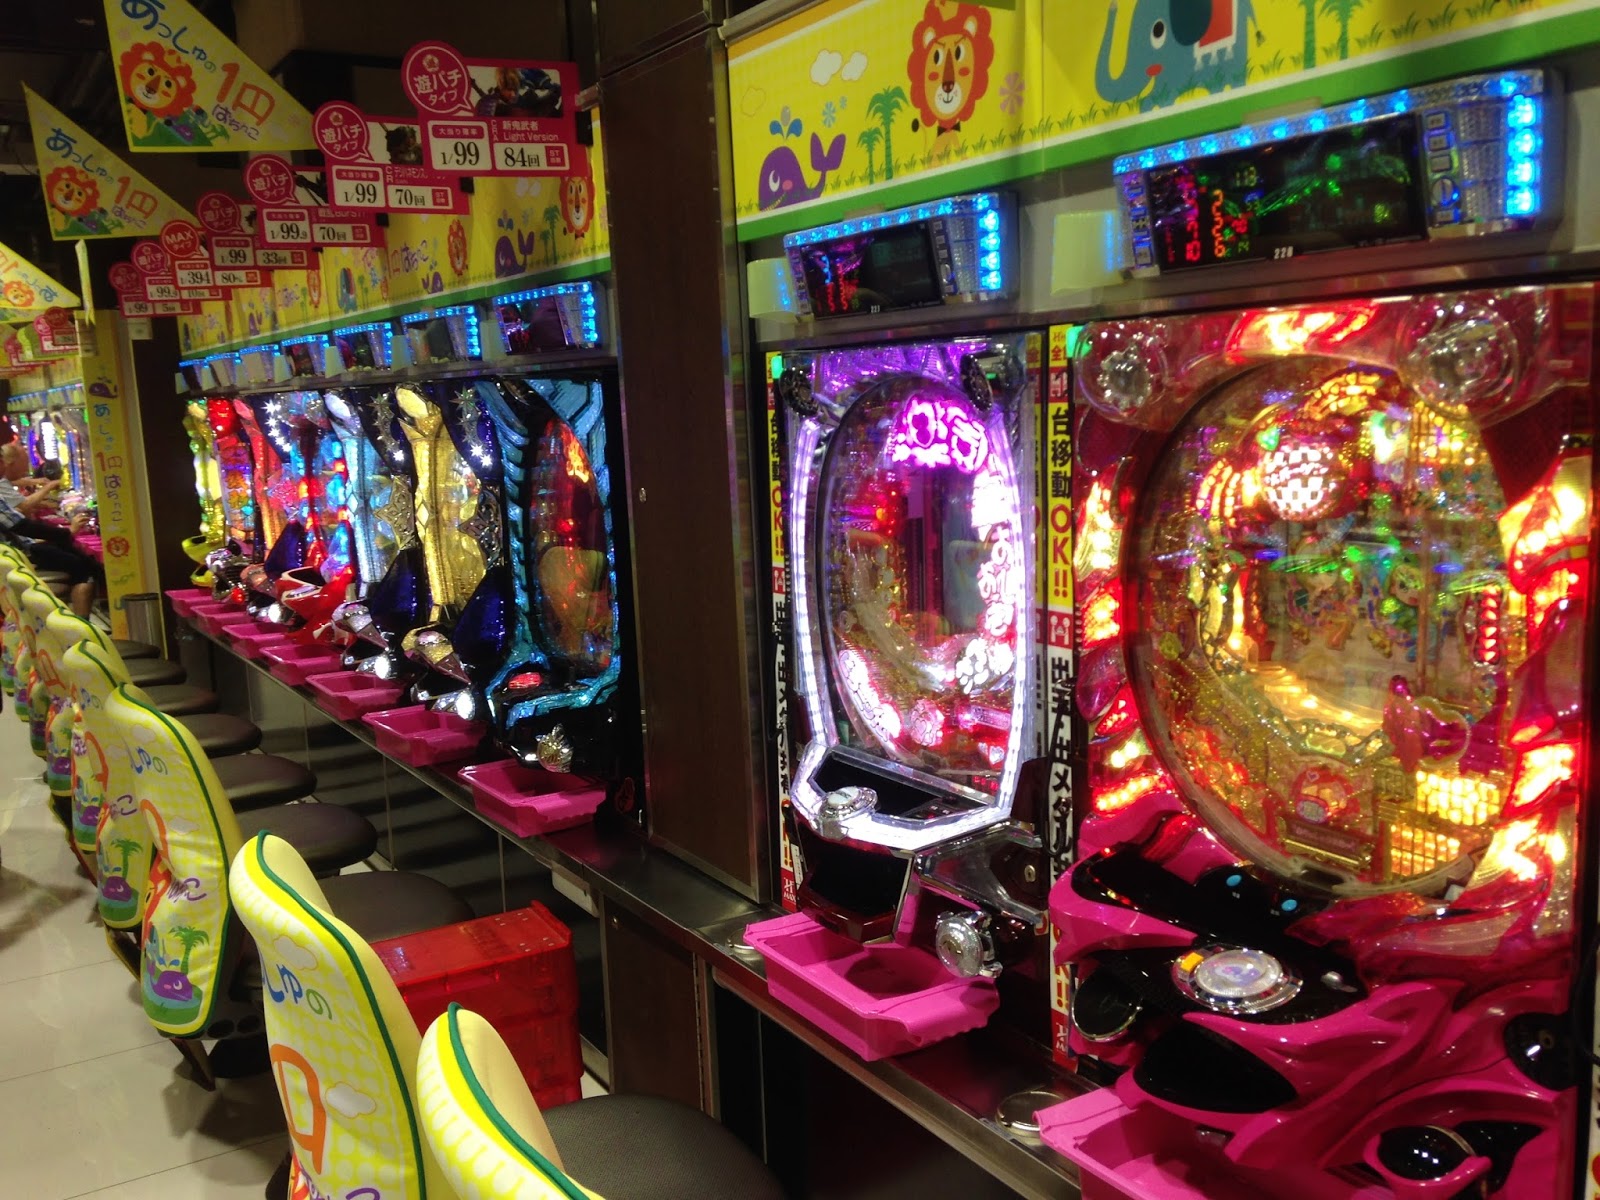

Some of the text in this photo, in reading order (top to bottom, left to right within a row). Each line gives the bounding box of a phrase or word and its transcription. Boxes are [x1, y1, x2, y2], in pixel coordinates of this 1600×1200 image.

[414, 69, 462, 94] 遊パチ
[428, 90, 458, 106] タイプ
[322, 124, 362, 144] 遊パチ
[504, 132, 559, 142] Light Version
[334, 141, 358, 153] タイプ
[441, 141, 480, 165] 1/99
[344, 183, 377, 204] 1/99
[165, 230, 194, 244] MAX
